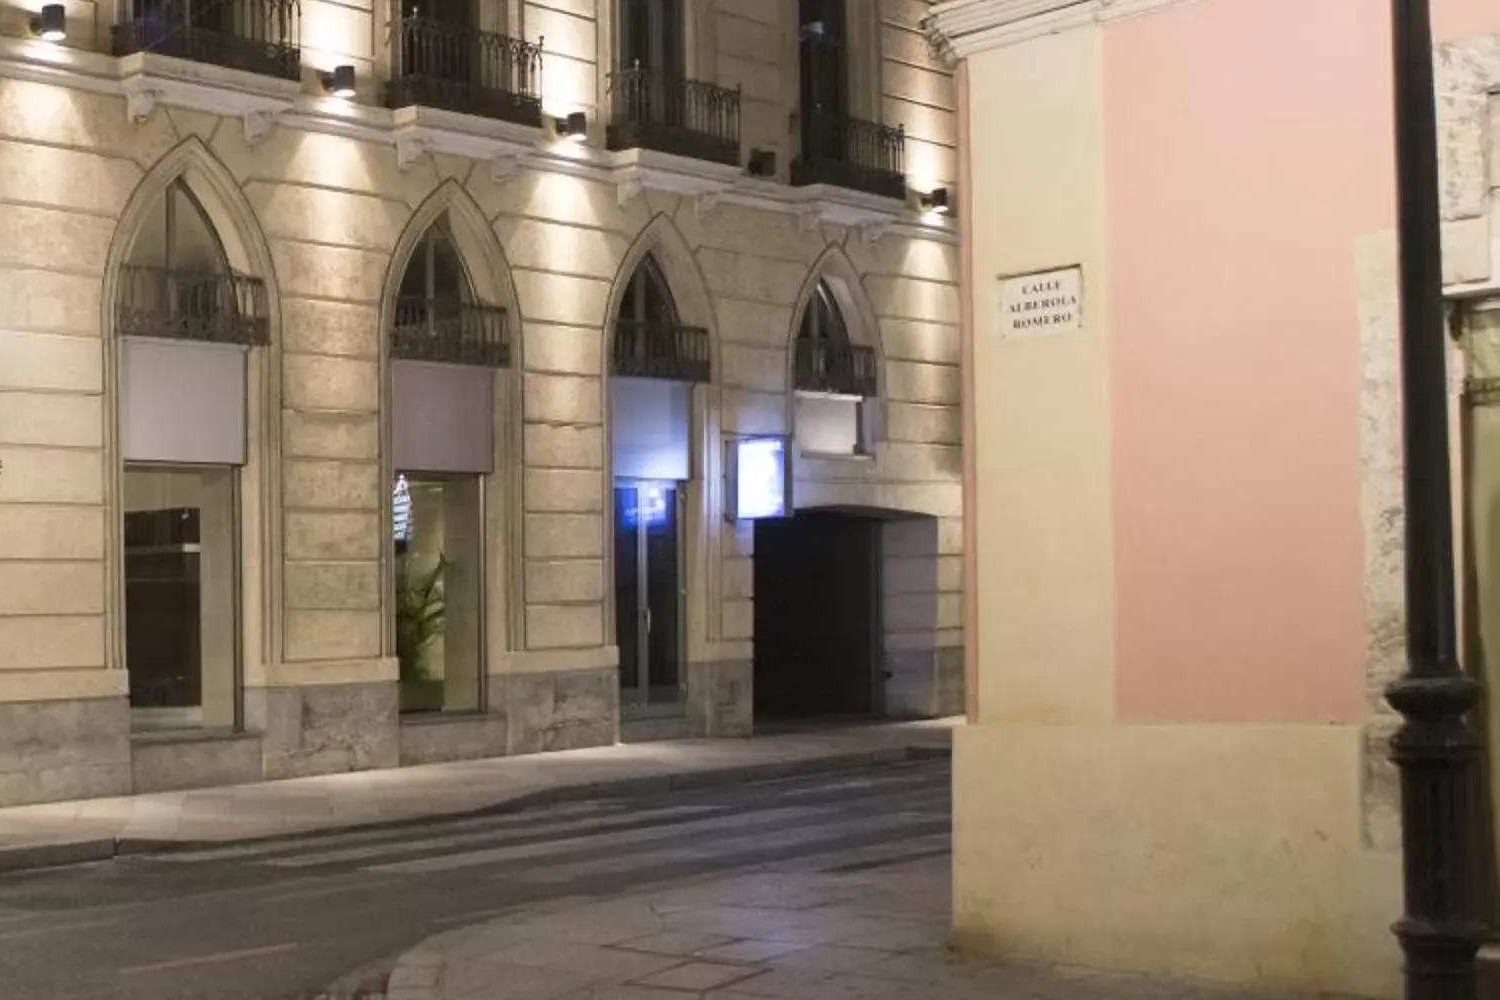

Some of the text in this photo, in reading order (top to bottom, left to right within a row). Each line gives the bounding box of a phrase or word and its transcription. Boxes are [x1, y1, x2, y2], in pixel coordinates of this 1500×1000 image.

[1021, 281, 1060, 294] CALLE
[1010, 295, 1077, 312] ALBEROLA
[1013, 313, 1072, 328] ROMERO
